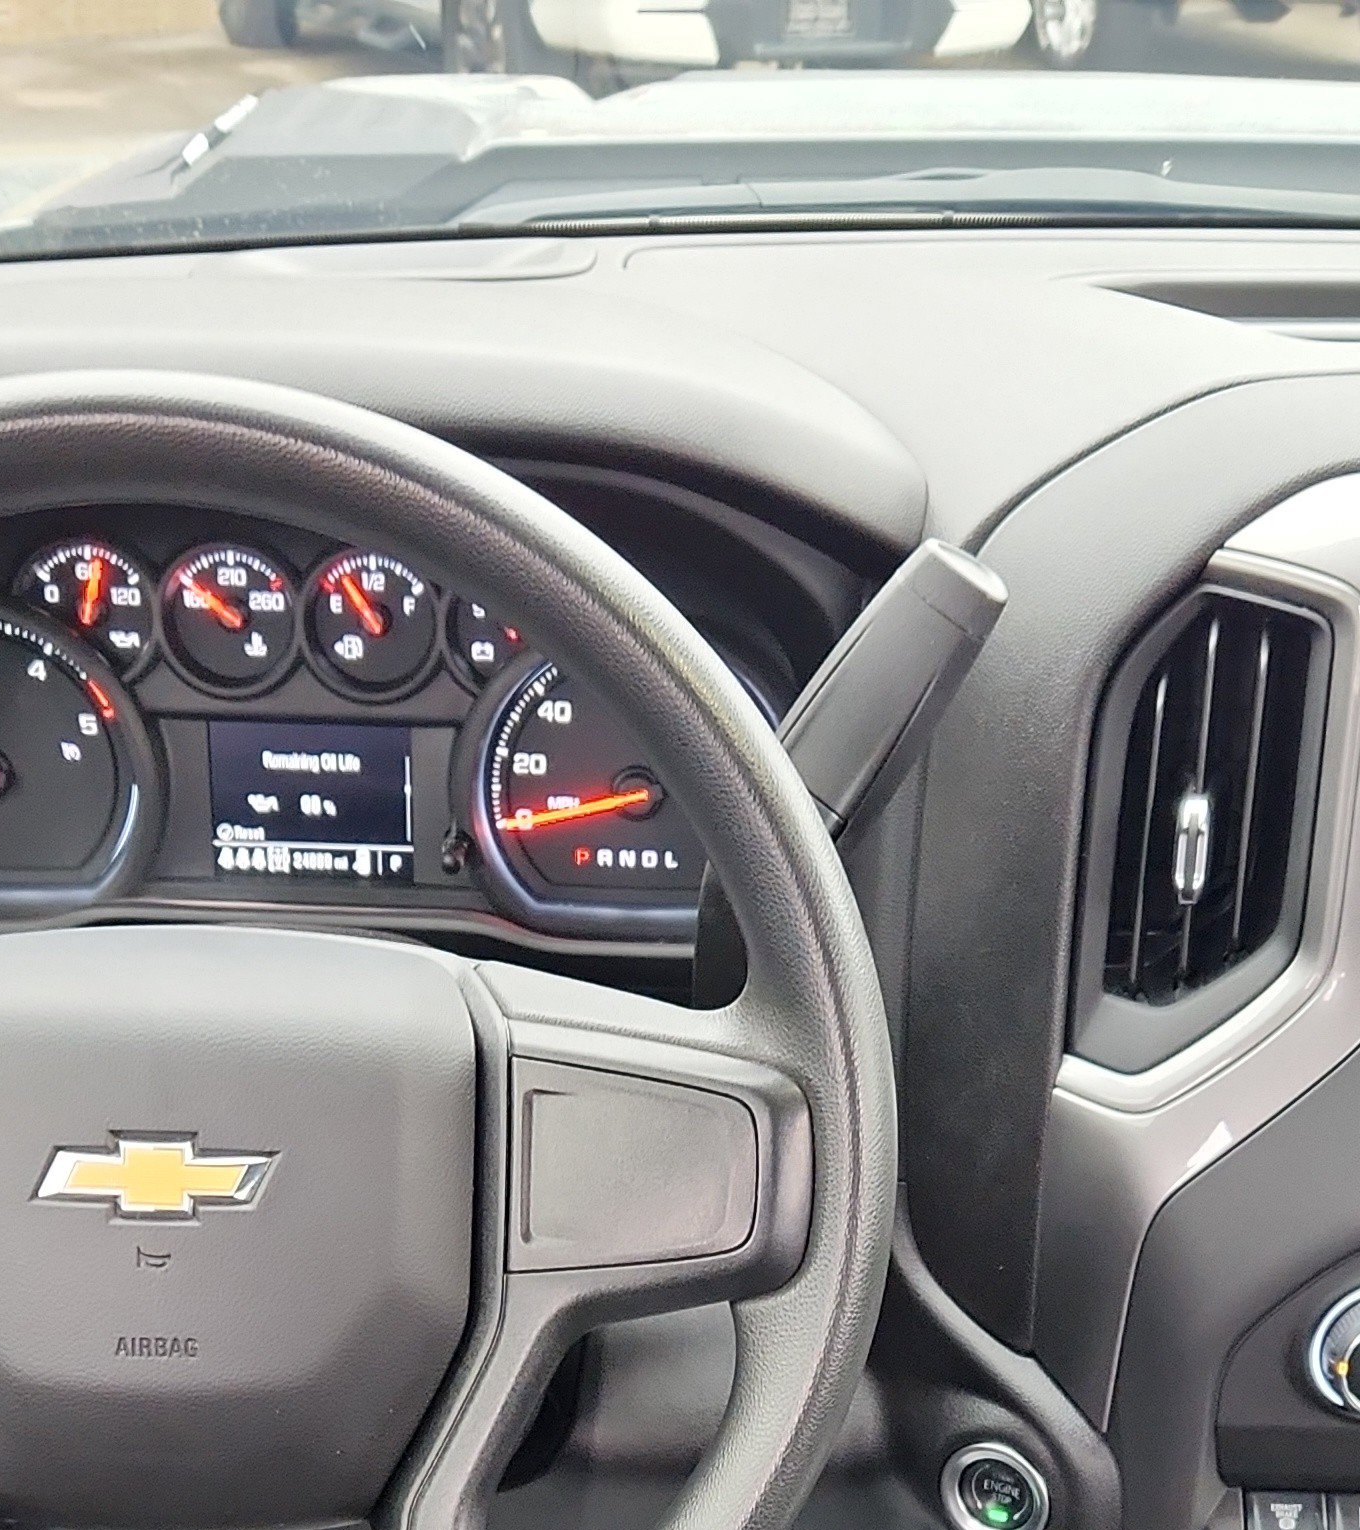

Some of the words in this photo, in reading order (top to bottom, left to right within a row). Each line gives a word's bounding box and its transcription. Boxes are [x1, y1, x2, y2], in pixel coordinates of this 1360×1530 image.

[217, 567, 248, 586] 210
[361, 571, 385, 592] 1/2
[44, 584, 60, 603] 0
[110, 587, 140, 605] 120
[249, 591, 285, 612] 260
[330, 593, 343, 614] E
[403, 595, 416, 616] F
[27, 659, 48, 682] 4
[538, 700, 573, 724] 40
[78, 713, 99, 736] 5
[262, 750, 320, 774] Remaining
[513, 753, 547, 775] 20
[115, 1336, 199, 1358] AIRBAG
[983, 1478, 1022, 1501] ENGINE
